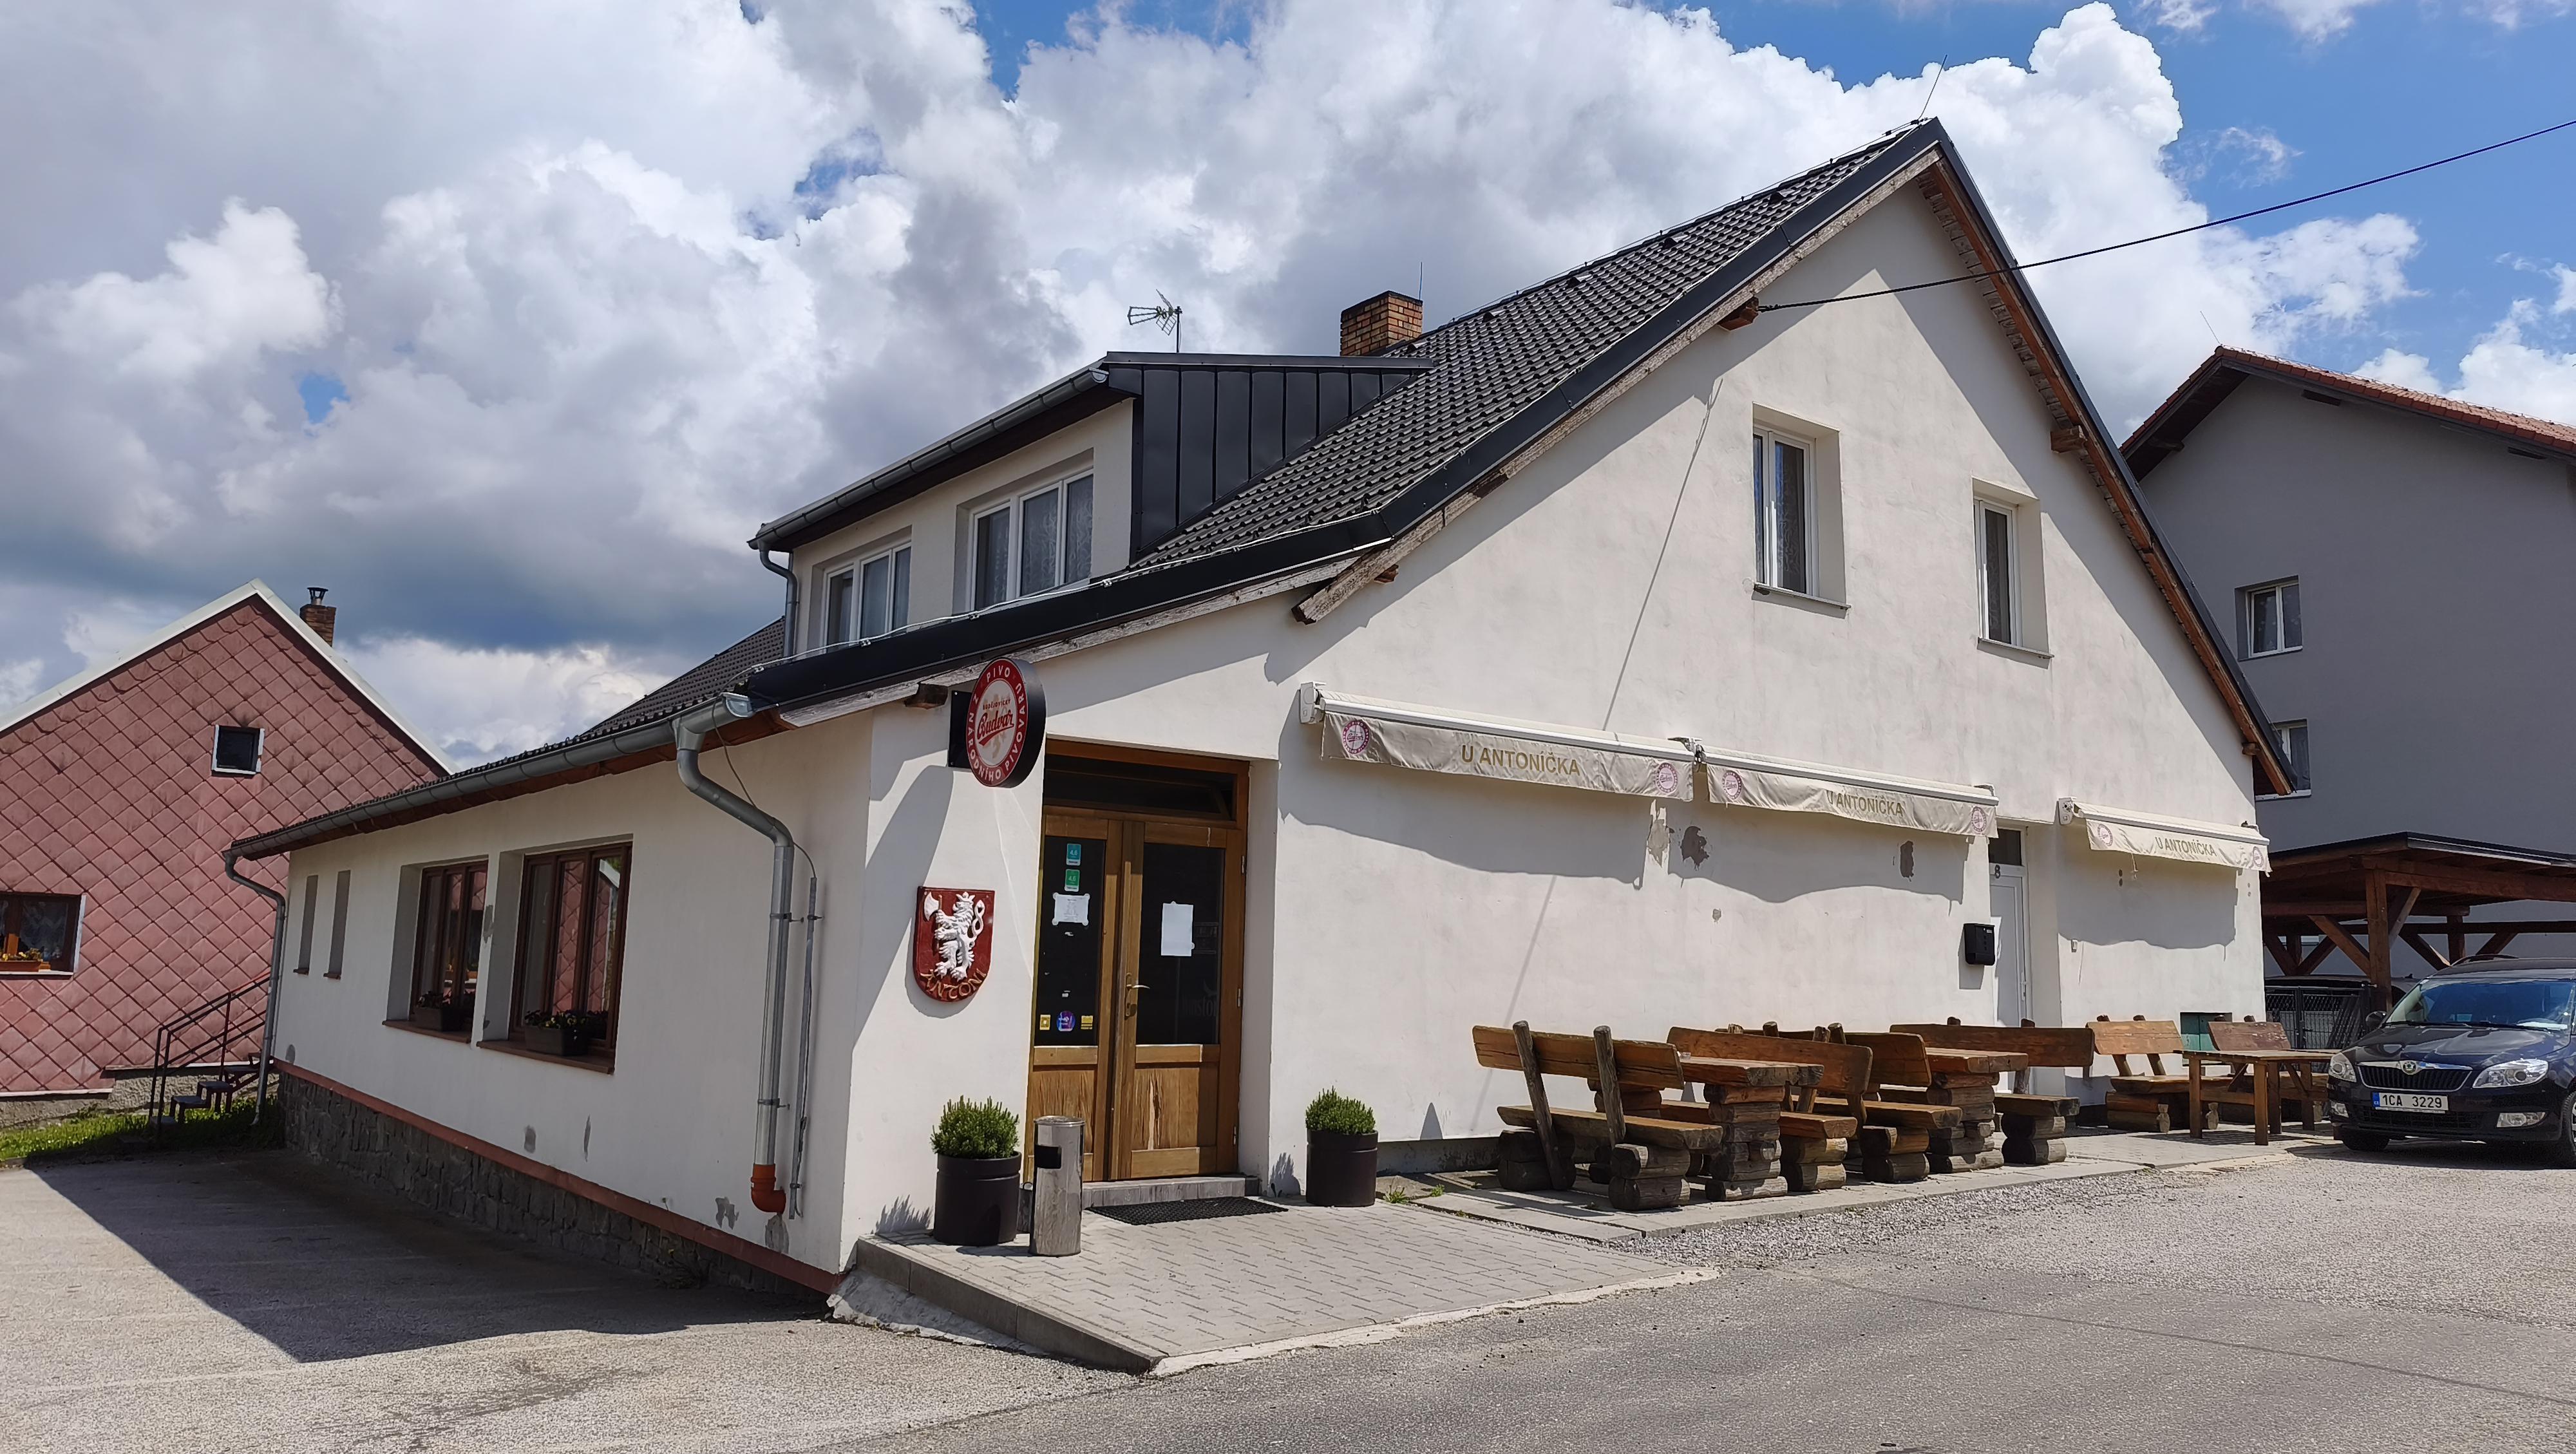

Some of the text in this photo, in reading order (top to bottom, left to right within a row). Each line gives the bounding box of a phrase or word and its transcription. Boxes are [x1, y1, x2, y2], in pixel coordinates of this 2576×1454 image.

[987, 665, 1010, 683] PIVO
[968, 682, 1025, 782] Z NÁRODNÍHO PIVOVARU
[1462, 744, 1580, 776] U ANTONÍČKA
[1826, 789, 1903, 817] U ANTONÍČKA
[2155, 836, 2217, 856] U ANTONÍČKA
[1994, 864, 2001, 879] 8
[920, 968, 987, 999] ANTONI
[2382, 1094, 2442, 1108] 1CA 3229
